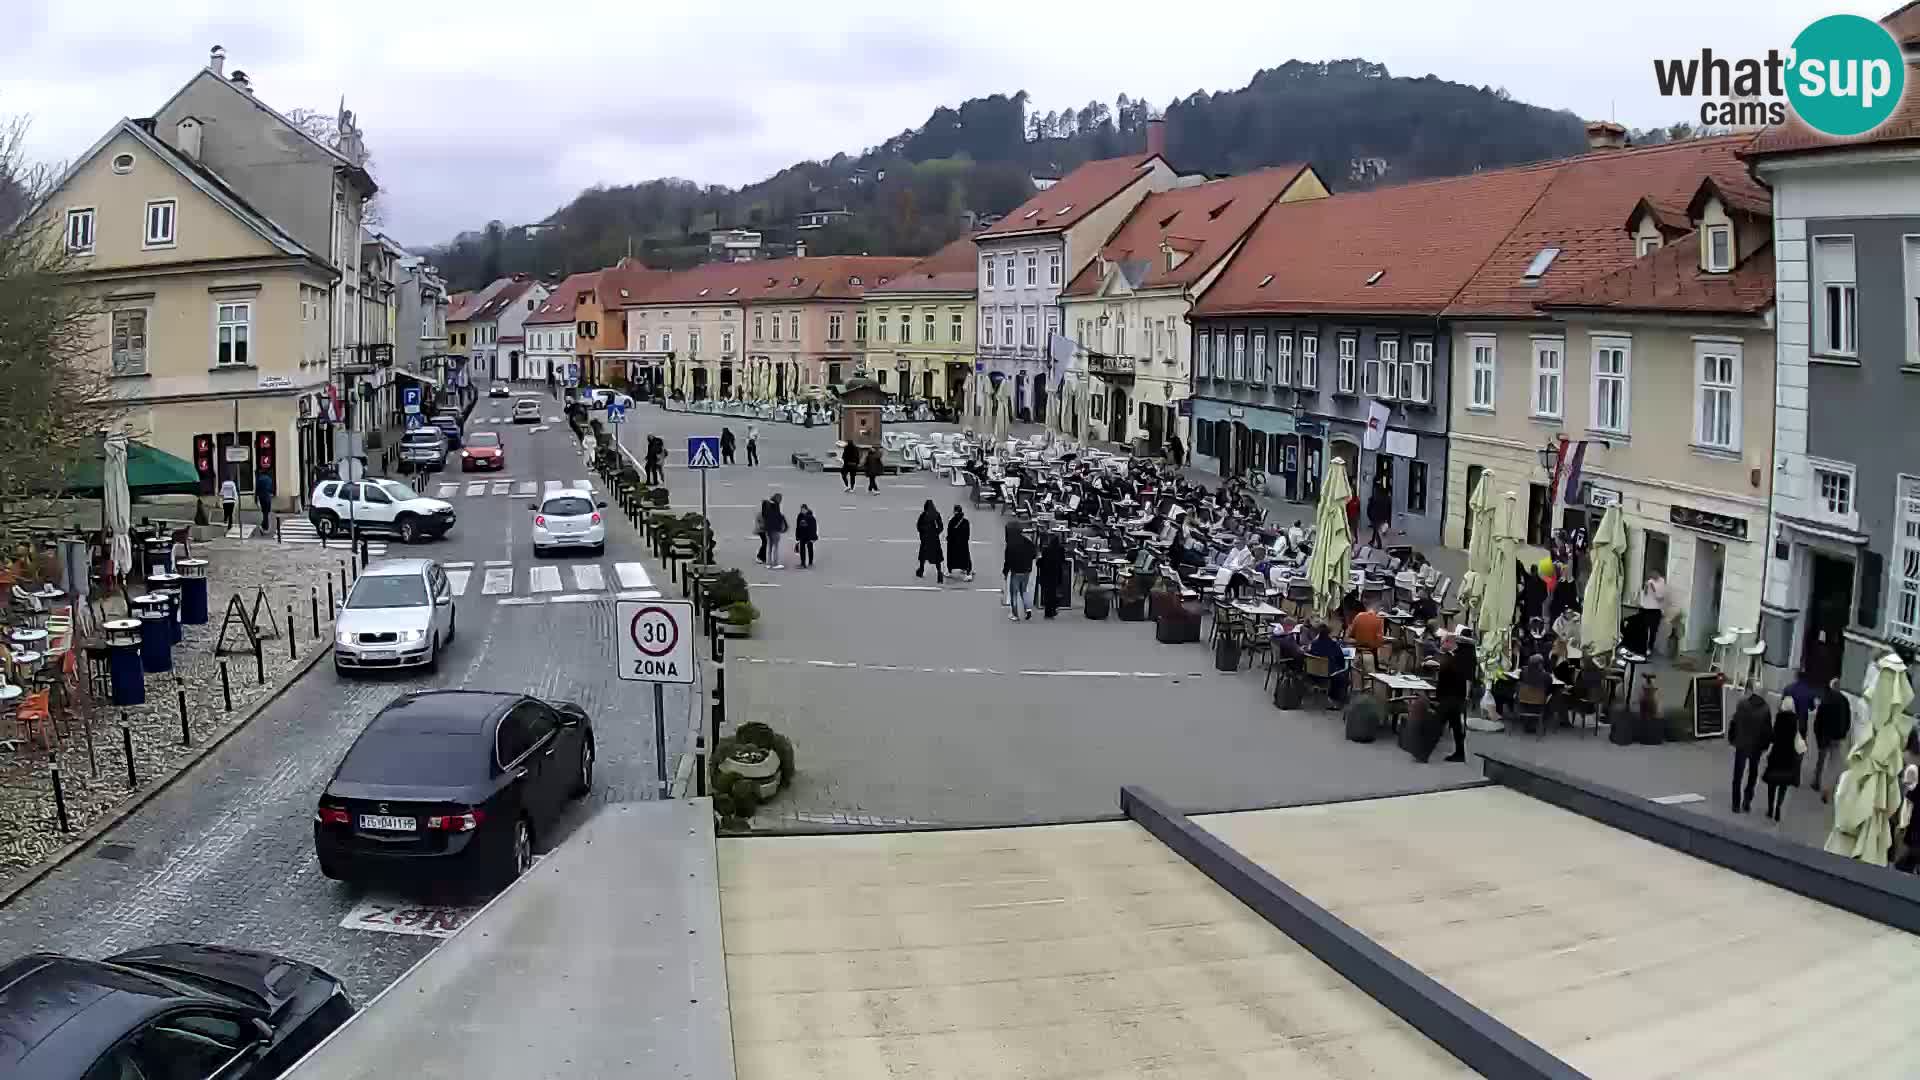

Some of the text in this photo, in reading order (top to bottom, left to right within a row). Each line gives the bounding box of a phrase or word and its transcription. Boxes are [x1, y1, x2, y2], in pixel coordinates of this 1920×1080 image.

[408, 391, 416, 403] P
[643, 622, 667, 643] 30
[633, 660, 678, 676] ZONA
